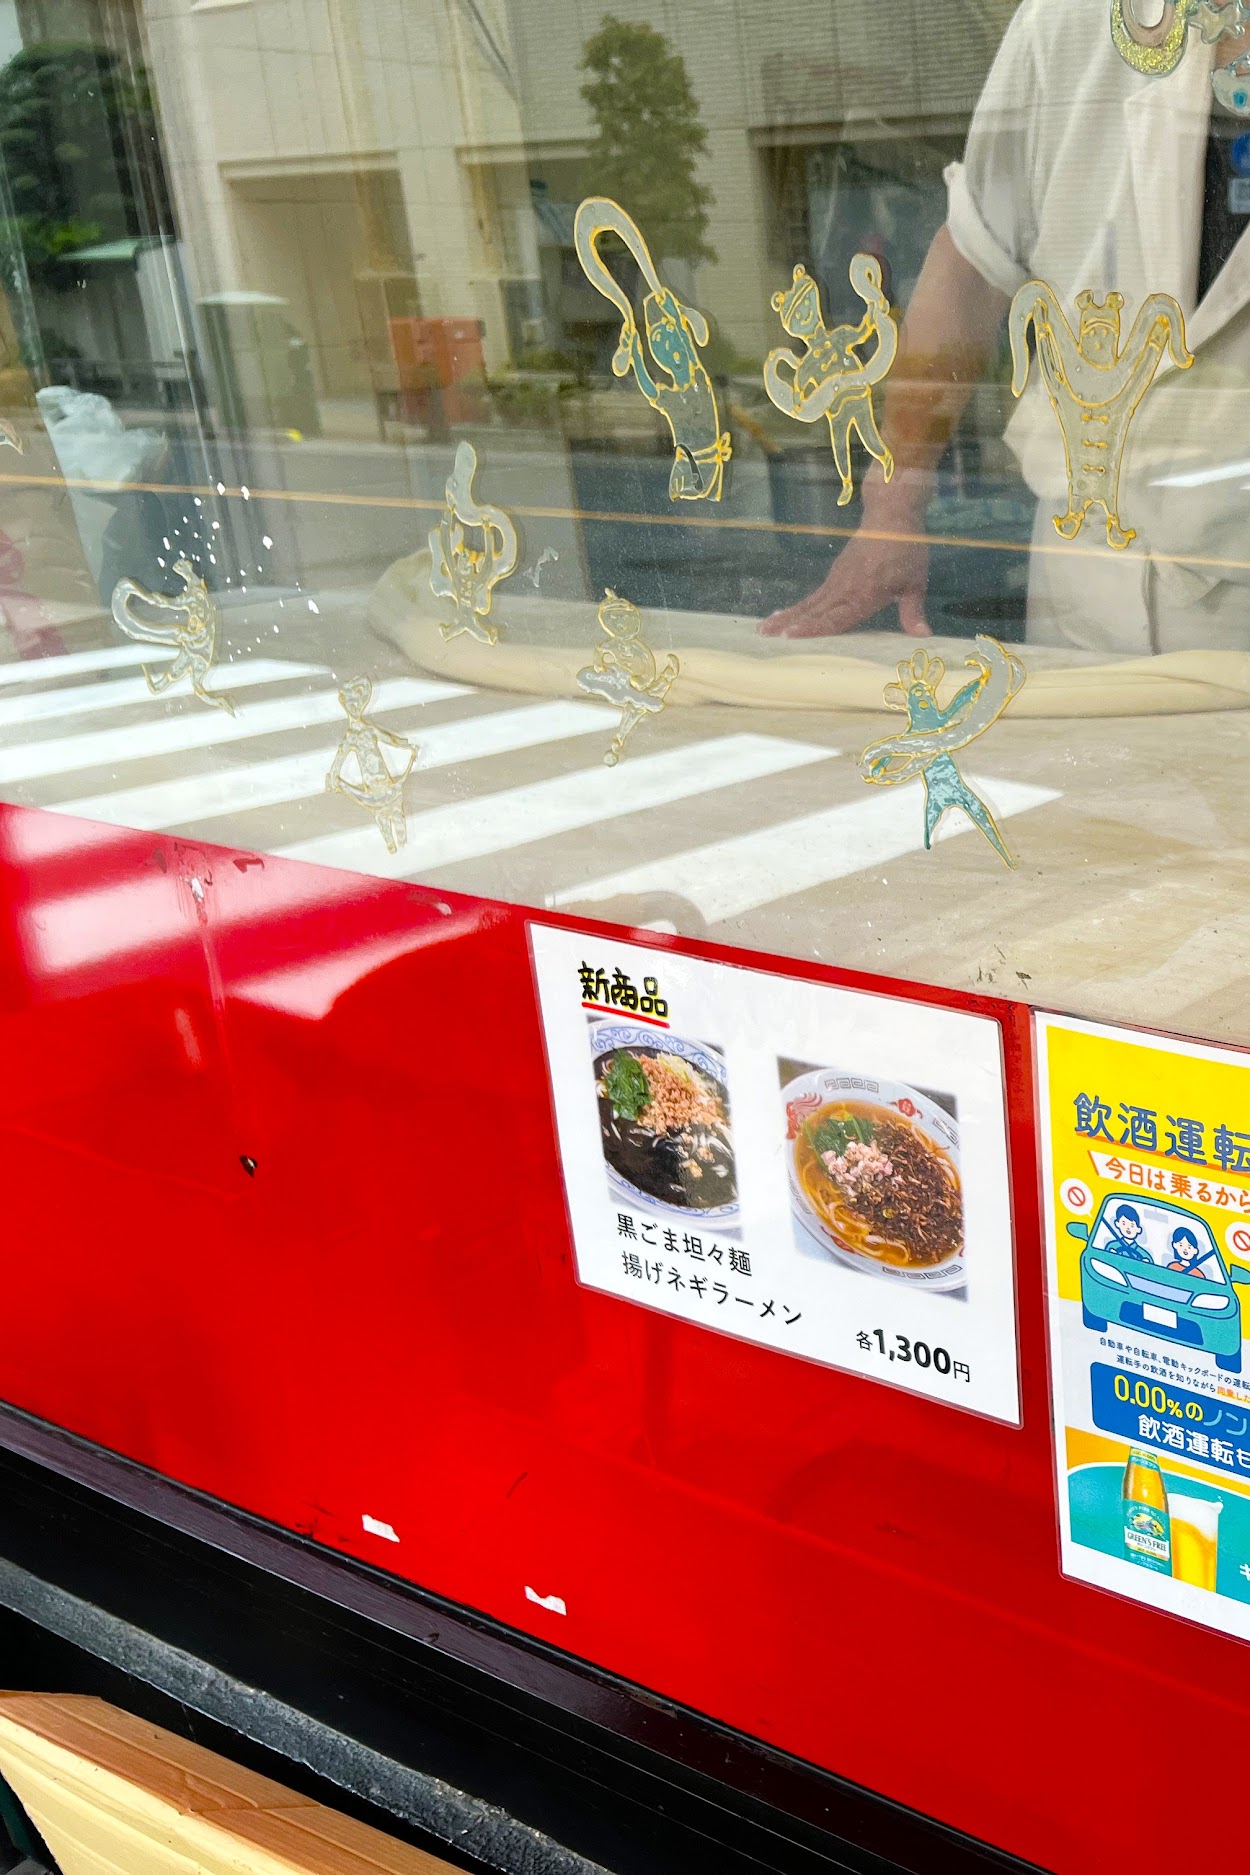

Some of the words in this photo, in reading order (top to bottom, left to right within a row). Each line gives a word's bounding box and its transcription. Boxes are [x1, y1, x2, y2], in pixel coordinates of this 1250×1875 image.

[578, 961, 668, 1018] 新商品
[621, 1250, 803, 1326] 揚げネギラーメン
[1152, 1540, 1167, 1551] FREE
